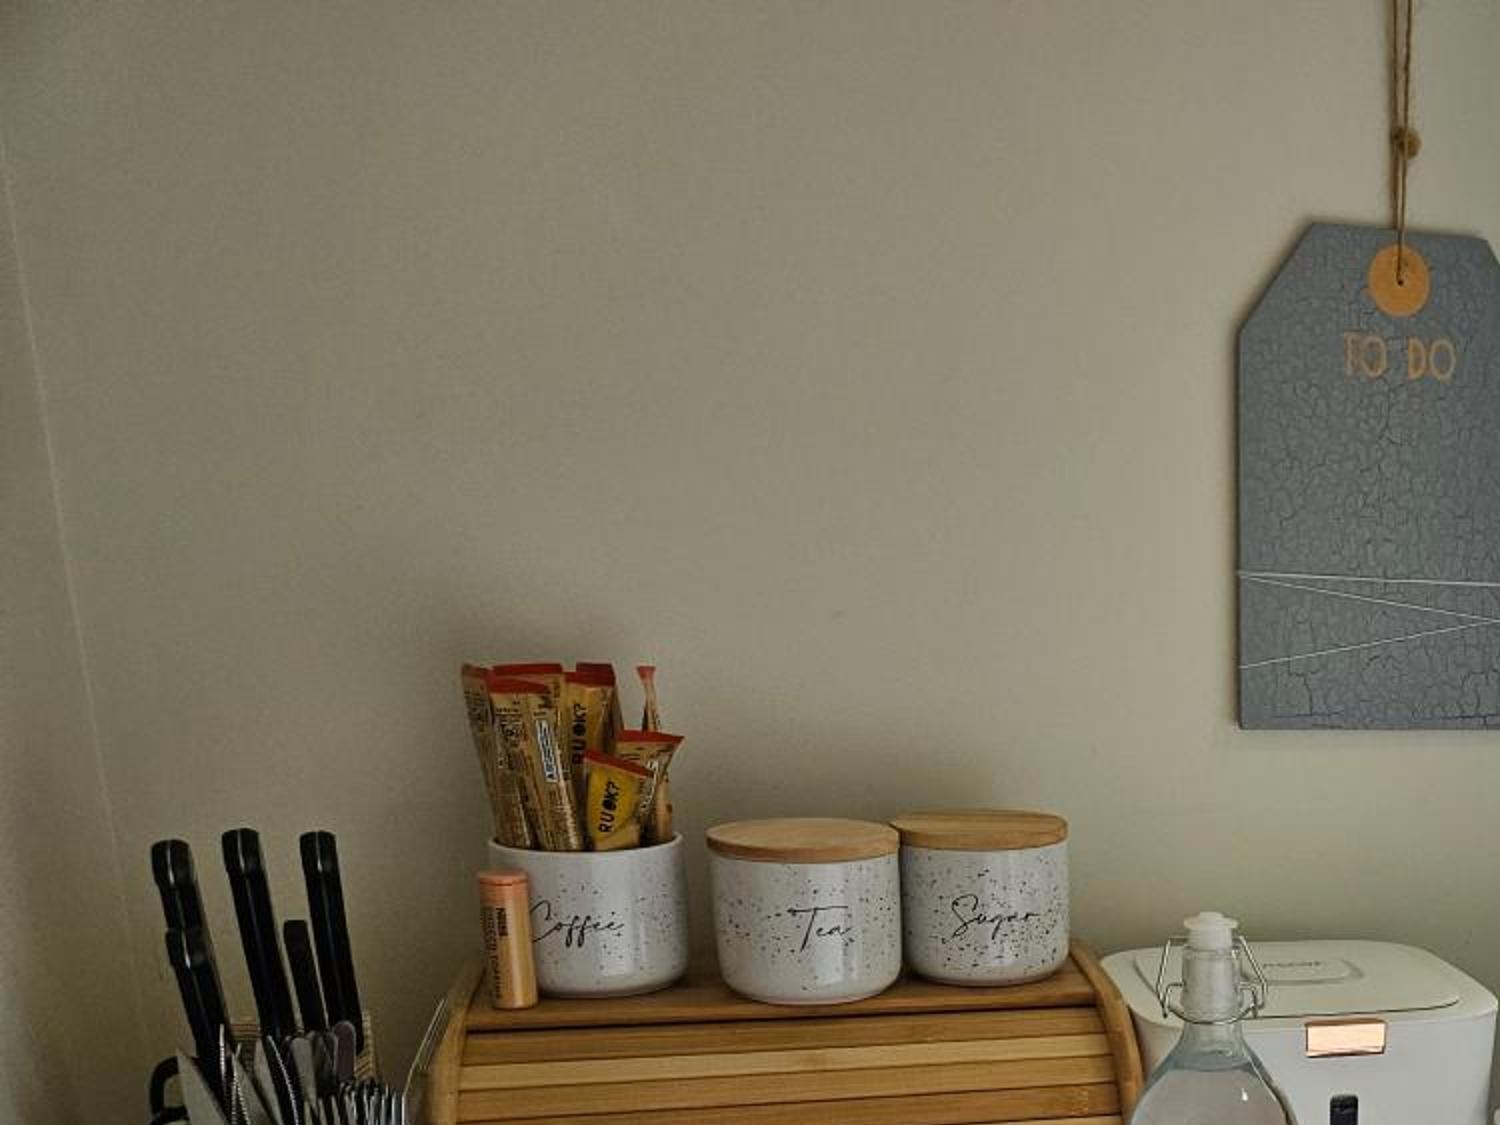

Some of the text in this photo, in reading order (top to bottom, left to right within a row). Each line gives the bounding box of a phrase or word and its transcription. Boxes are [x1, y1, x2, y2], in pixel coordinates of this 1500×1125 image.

[1344, 331, 1457, 382] TO DO
[528, 899, 625, 948] Coffee
[786, 905, 852, 952] Tea
[950, 893, 1041, 941] Sugar
